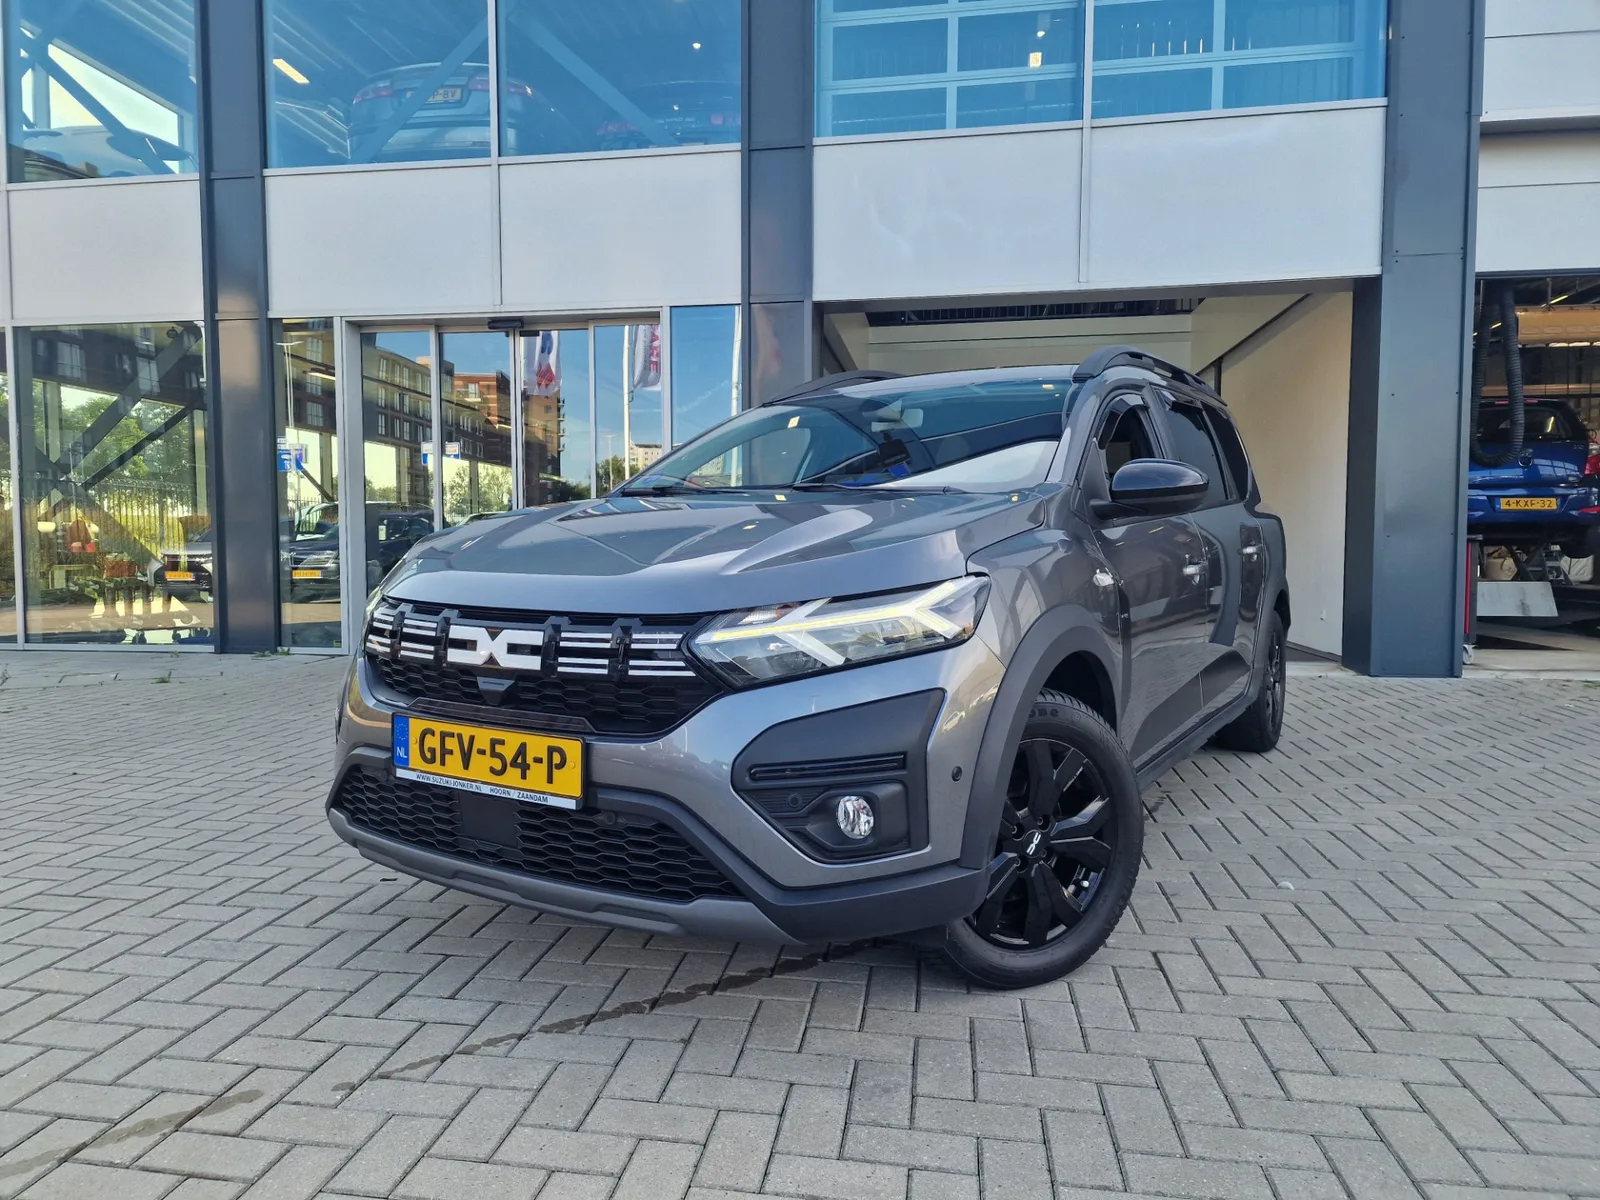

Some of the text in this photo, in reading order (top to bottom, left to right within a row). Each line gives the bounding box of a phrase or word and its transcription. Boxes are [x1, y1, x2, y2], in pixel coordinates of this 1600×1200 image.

[1504, 499, 1552, 508] 4-KXF-32
[396, 746, 408, 759] NL
[418, 727, 567, 784] GFV-54-P
[489, 787, 512, 798] HOORN
[517, 791, 549, 804] ZAANDAM
